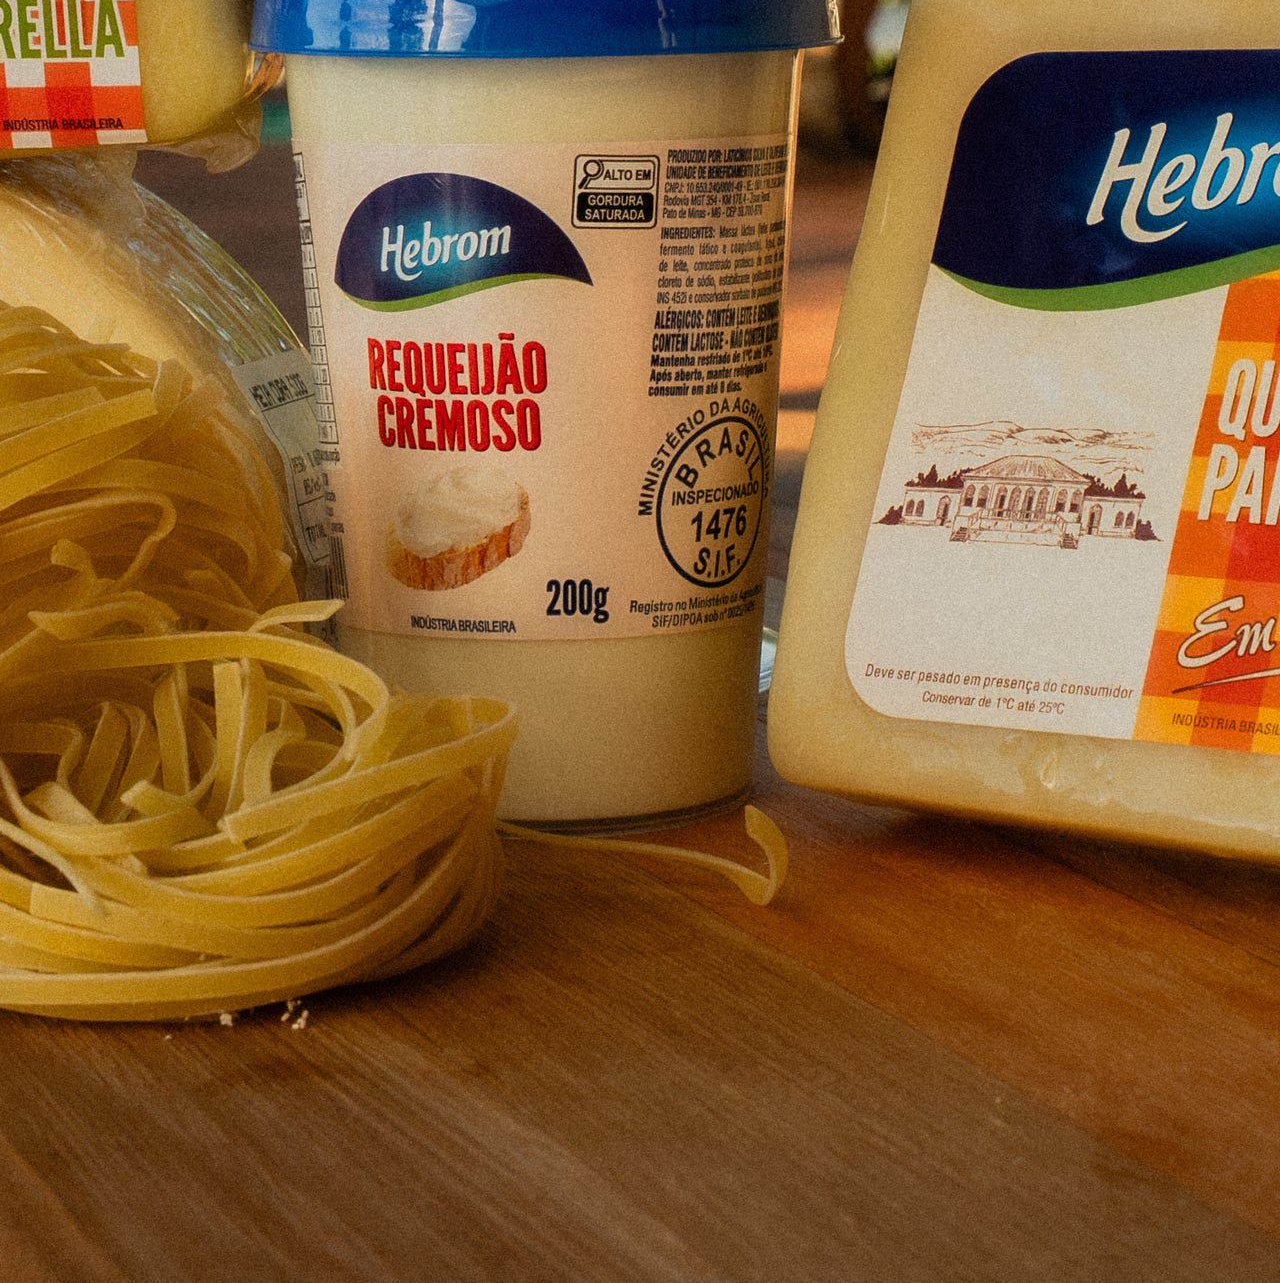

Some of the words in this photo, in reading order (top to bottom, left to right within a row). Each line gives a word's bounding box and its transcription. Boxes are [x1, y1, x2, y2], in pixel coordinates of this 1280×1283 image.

[3, 118, 59, 131] INDÚSTRIA
[62, 118, 124, 130] BRASILEIRA
[668, 149, 706, 163] PRODUZIDO
[603, 170, 632, 181] ALTO
[636, 170, 652, 181] EM
[666, 166, 696, 179] UNIDADE
[698, 166, 706, 179] DE
[587, 195, 644, 206] GORDURA
[664, 195, 689, 206] Rodovia
[691, 194, 705, 206] MGT
[584, 208, 645, 220] SATURADA
[679, 208, 686, 218] de
[688, 208, 706, 218] Minas
[712, 206, 721, 218] MG
[661, 226, 716, 238] INGREDIENTES:
[381, 221, 511, 281] Hebrom
[660, 244, 694, 256] fermento
[659, 260, 668, 272] de
[672, 259, 689, 274] leite,
[694, 258, 731, 271] concentrado
[658, 276, 682, 288] cloreto
[686, 276, 694, 288] de
[697, 276, 716, 289] sódio,
[657, 292, 670, 304] INS
[688, 294, 692, 304] e
[694, 290, 731, 304] conservador
[654, 306, 704, 330] ALÉRGICOS:
[706, 304, 736, 328] CONTÉM
[690, 331, 724, 352] LACTOSE
[367, 332, 548, 397] REQUEIJÃO
[650, 354, 695, 367] Mantenha
[698, 352, 731, 366] resfriado
[732, 350, 740, 364] de
[650, 368, 672, 385] Após
[674, 368, 705, 382] aberto,
[706, 366, 733, 380] manter
[648, 382, 690, 397] consumir
[692, 384, 704, 396] em
[706, 381, 718, 394] até
[377, 394, 542, 453] CREMOSO
[638, 409, 706, 516] MINISTÉRIO
[710, 398, 730, 417] DA
[674, 426, 761, 489] BRASIL
[672, 480, 759, 506] INSPECIONADO
[690, 504, 747, 542] 1476
[694, 544, 740, 578] S.I.F.
[546, 578, 610, 624] 200g
[630, 600, 672, 615] Registro
[676, 601, 686, 610] no
[689, 594, 728, 610] Ministério
[410, 614, 458, 632] INDÚSTRIA
[458, 619, 516, 633] BRASILEIRA
[652, 612, 703, 628] SIF/DIPOA
[704, 610, 719, 623] sob
[1177, 595, 1276, 668] Em
[865, 664, 894, 679] Deve
[896, 669, 915, 681] ser
[918, 668, 960, 686] pesado
[963, 674, 981, 686] em
[982, 676, 1040, 695] presença
[1043, 678, 1058, 693] do
[1060, 683, 1134, 699] consumidor
[922, 690, 974, 706] Conservar
[978, 695, 992, 708] de
[1017, 699, 1036, 712] até
